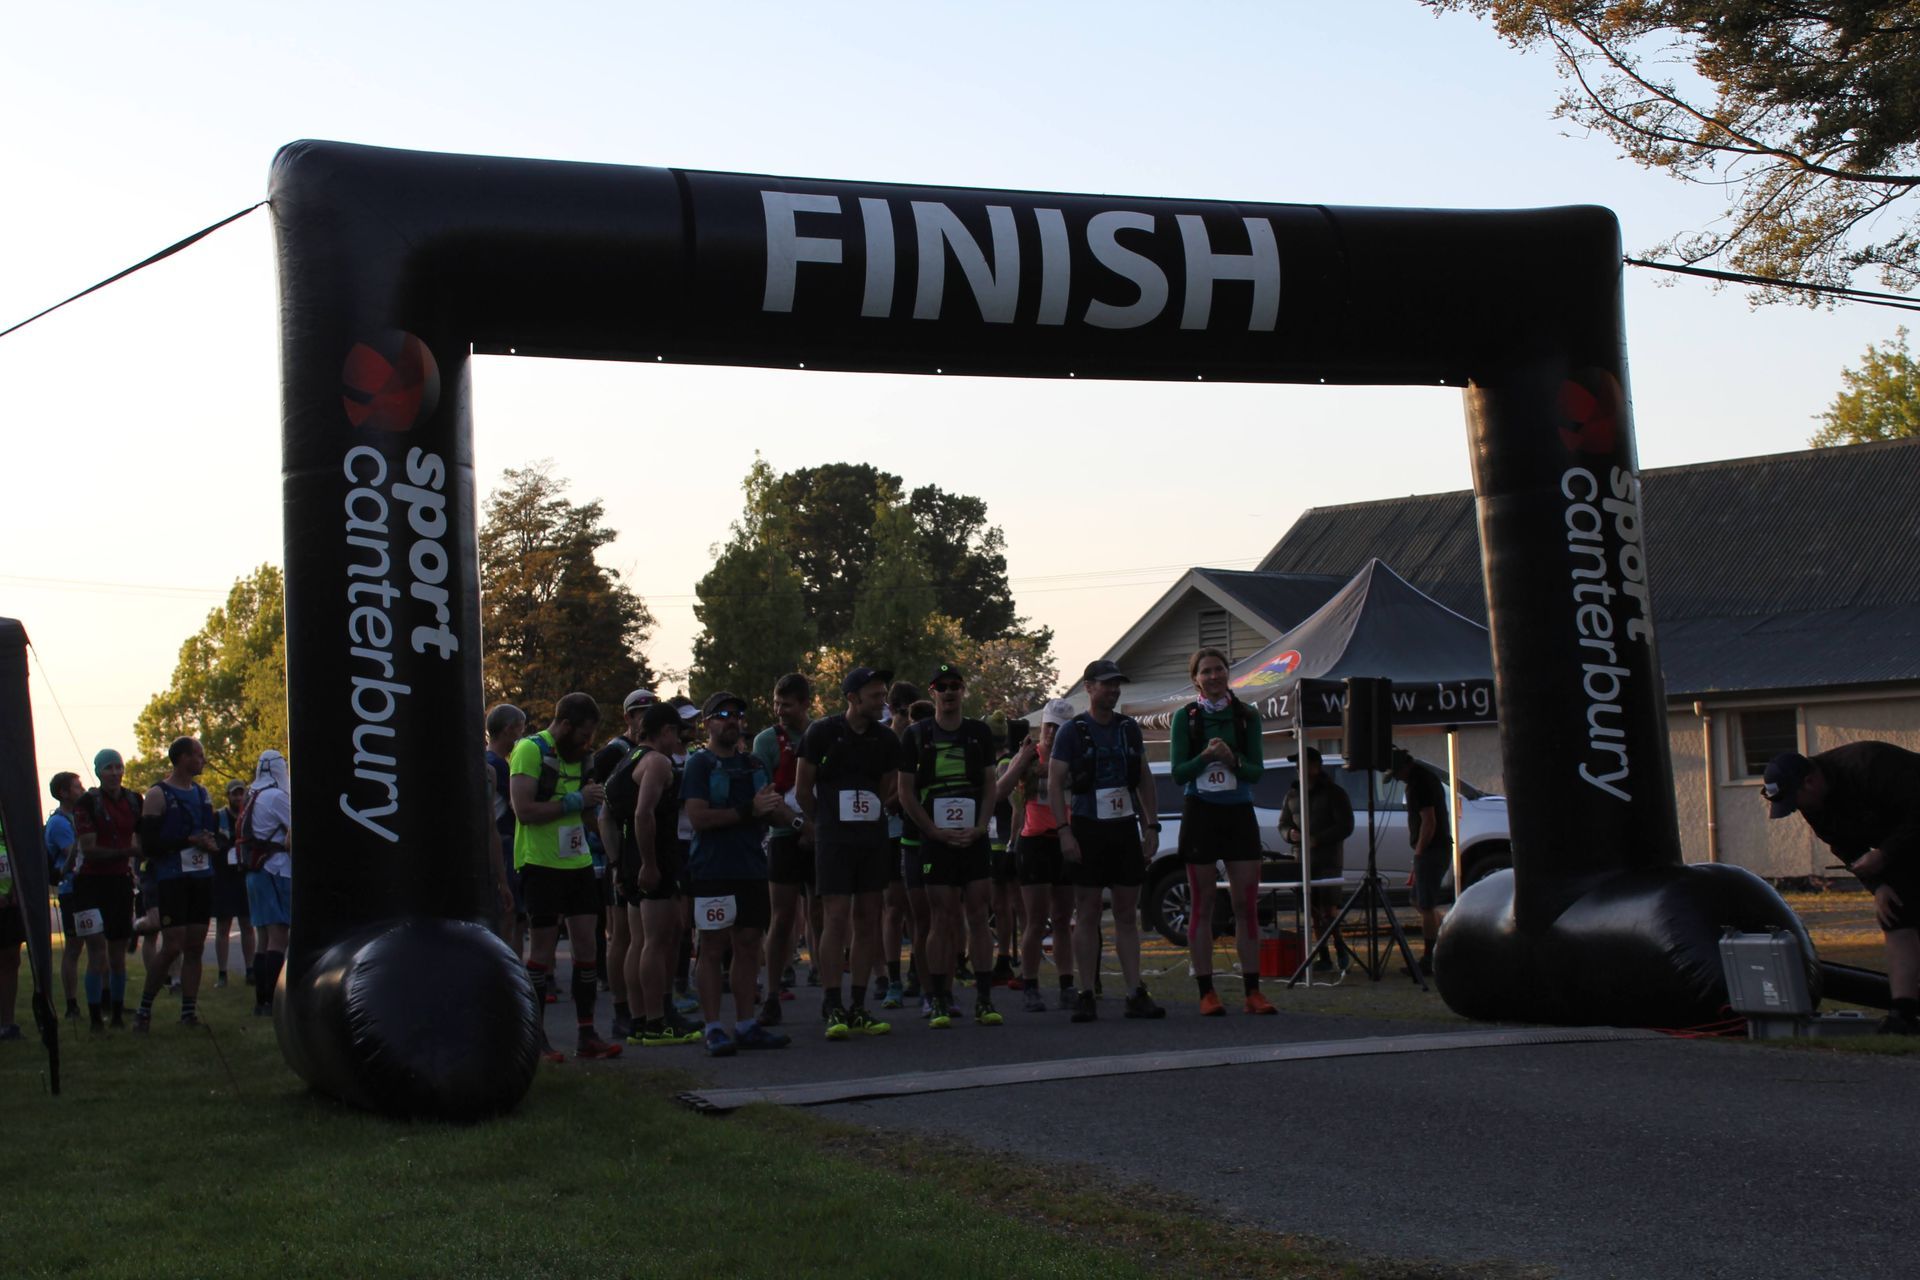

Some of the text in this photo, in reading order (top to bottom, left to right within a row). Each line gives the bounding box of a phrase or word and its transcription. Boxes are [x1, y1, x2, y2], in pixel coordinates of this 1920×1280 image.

[760, 189, 1282, 332] FINISH
[391, 446, 460, 660] sport
[1601, 464, 1655, 644] sport
[1560, 466, 1633, 803] canterbury
[338, 445, 412, 844] canterbury
[1322, 690, 1416, 713] ww
[1208, 771, 1225, 784] 40
[852, 801, 869, 814] 55
[1110, 797, 1123, 811] 14
[946, 808, 964, 821] 22
[191, 854, 204, 866] 32
[706, 908, 726, 922] 66
[79, 918, 94, 930] 49
